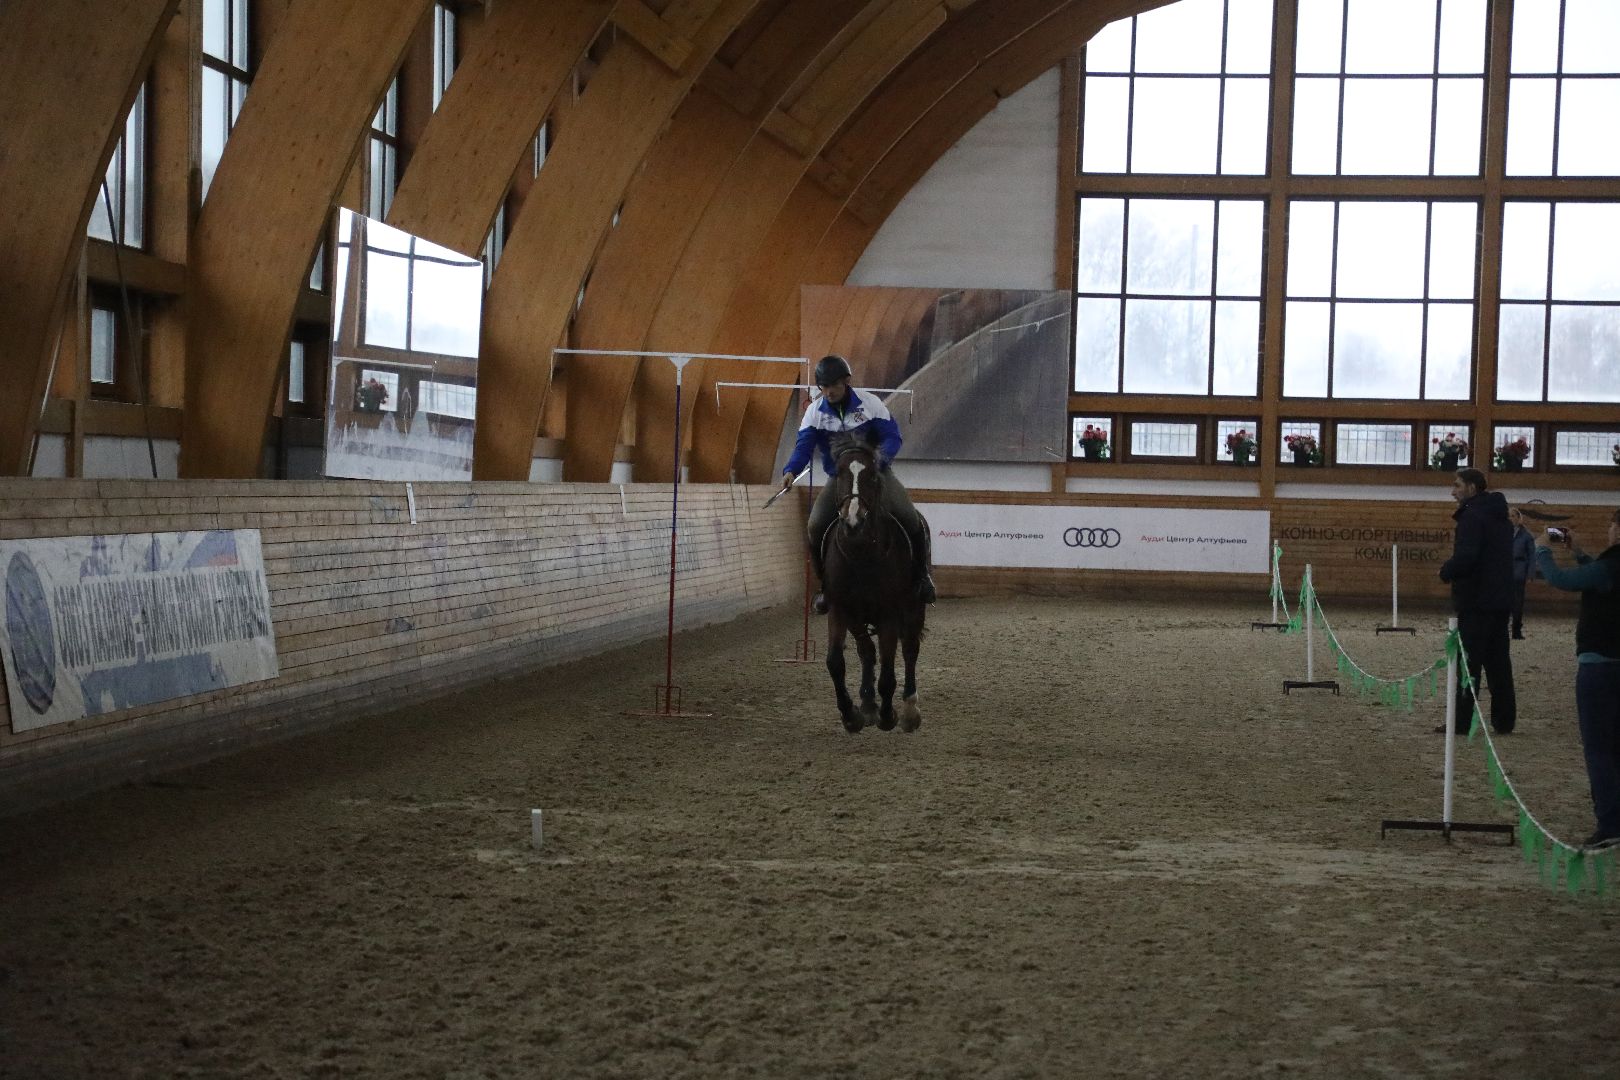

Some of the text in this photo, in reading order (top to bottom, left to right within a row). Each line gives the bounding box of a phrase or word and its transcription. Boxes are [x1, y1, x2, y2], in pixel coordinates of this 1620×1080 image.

[938, 530, 1044, 540] Ауди Центр Алтуфьево
[1140, 535, 1248, 545] Ауди Центр Алтуфьево
[1281, 527, 1450, 543] КОННО-СПОРТИВНЫЙ
